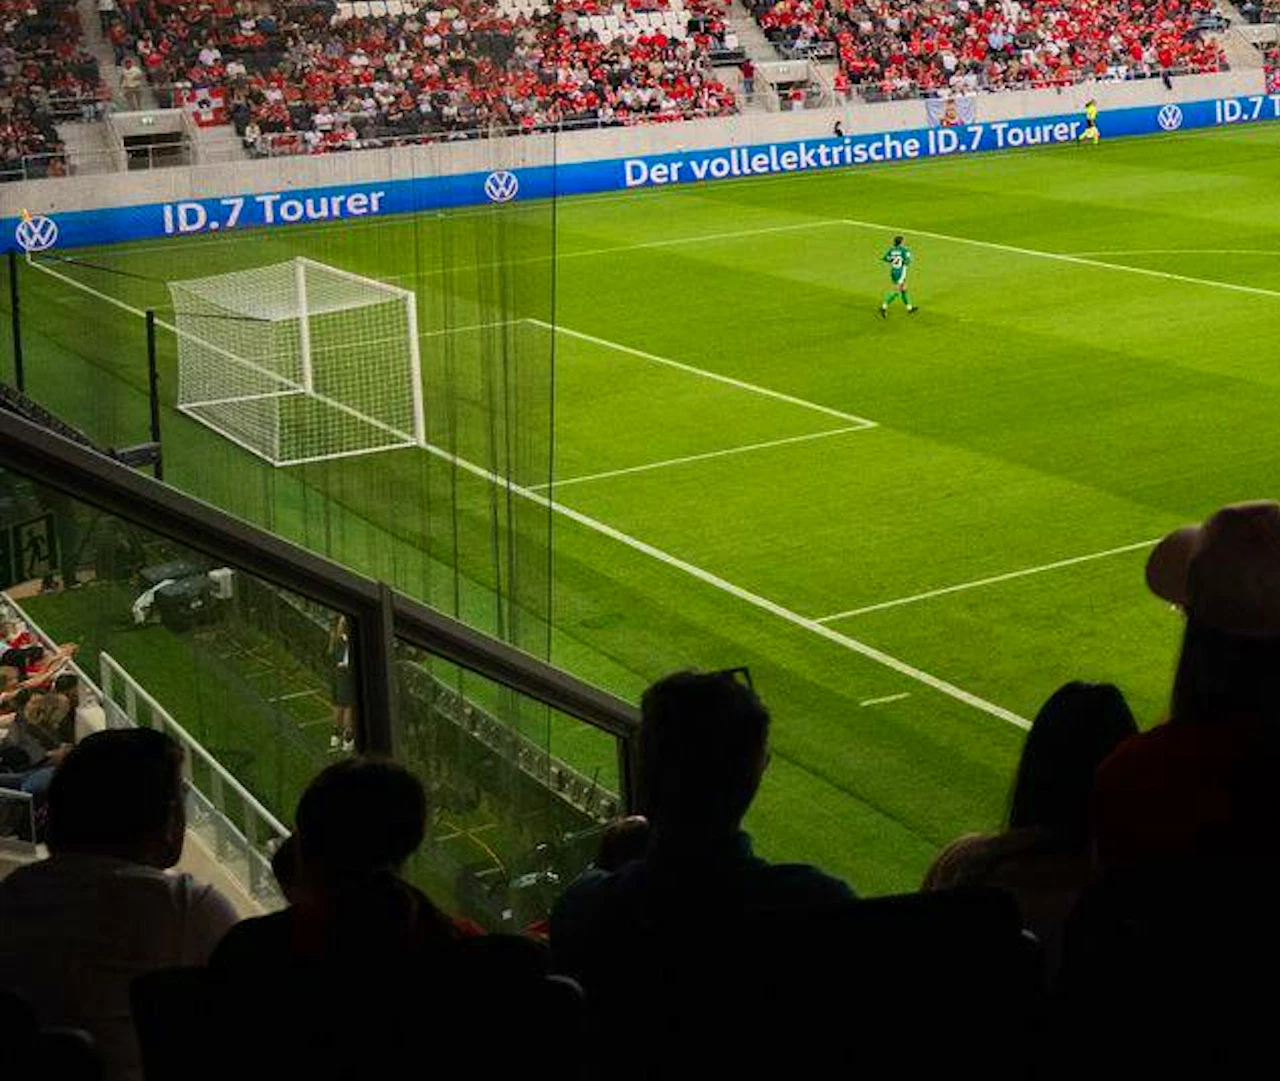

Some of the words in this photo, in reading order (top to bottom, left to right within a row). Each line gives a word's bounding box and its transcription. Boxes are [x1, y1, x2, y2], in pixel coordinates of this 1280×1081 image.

[1215, 95, 1263, 124] ID.7
[624, 159, 683, 186] Der
[688, 133, 921, 179] vollelektrische
[928, 124, 984, 155] ID.7
[990, 121, 1081, 148] Tourer
[163, 197, 244, 234] ID.7
[255, 190, 385, 224] Tourer
